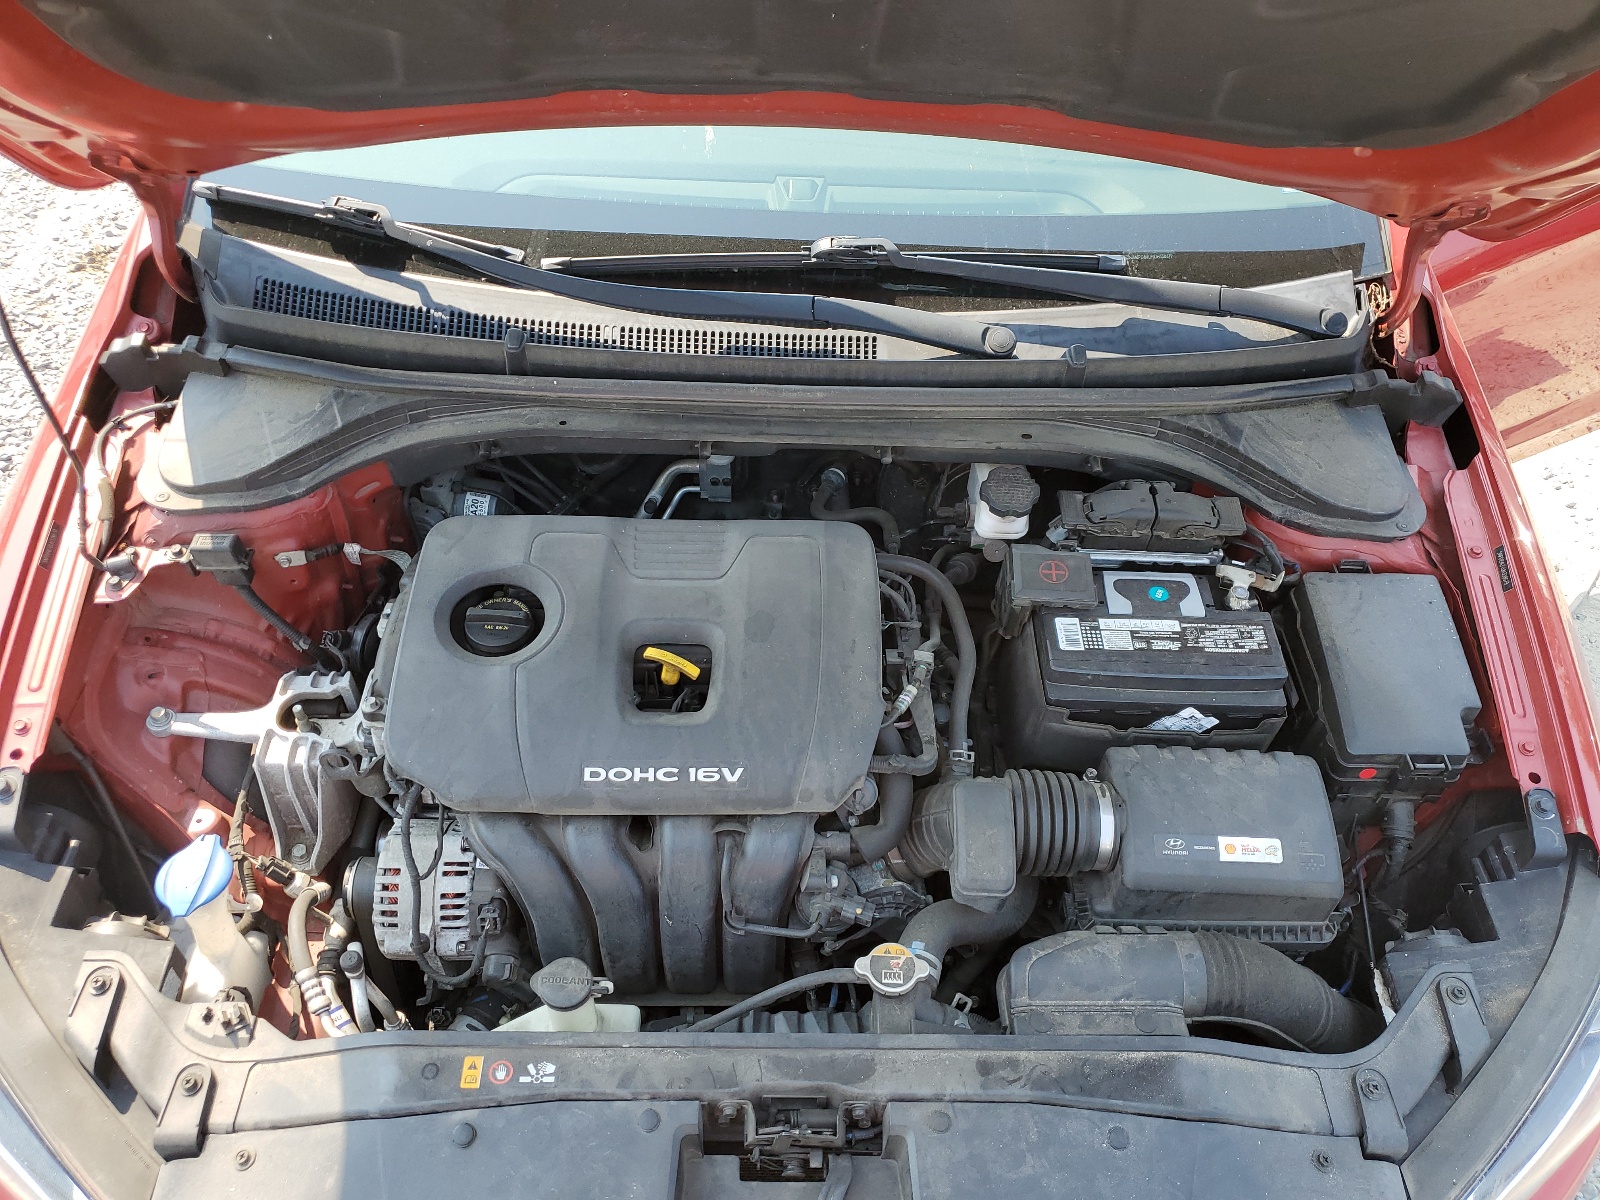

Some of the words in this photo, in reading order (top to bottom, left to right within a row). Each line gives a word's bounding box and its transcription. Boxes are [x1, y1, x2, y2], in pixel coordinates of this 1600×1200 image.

[583, 767, 680, 782] DOHC
[689, 767, 745, 782] 16V
[541, 976, 591, 986] COOLANT
